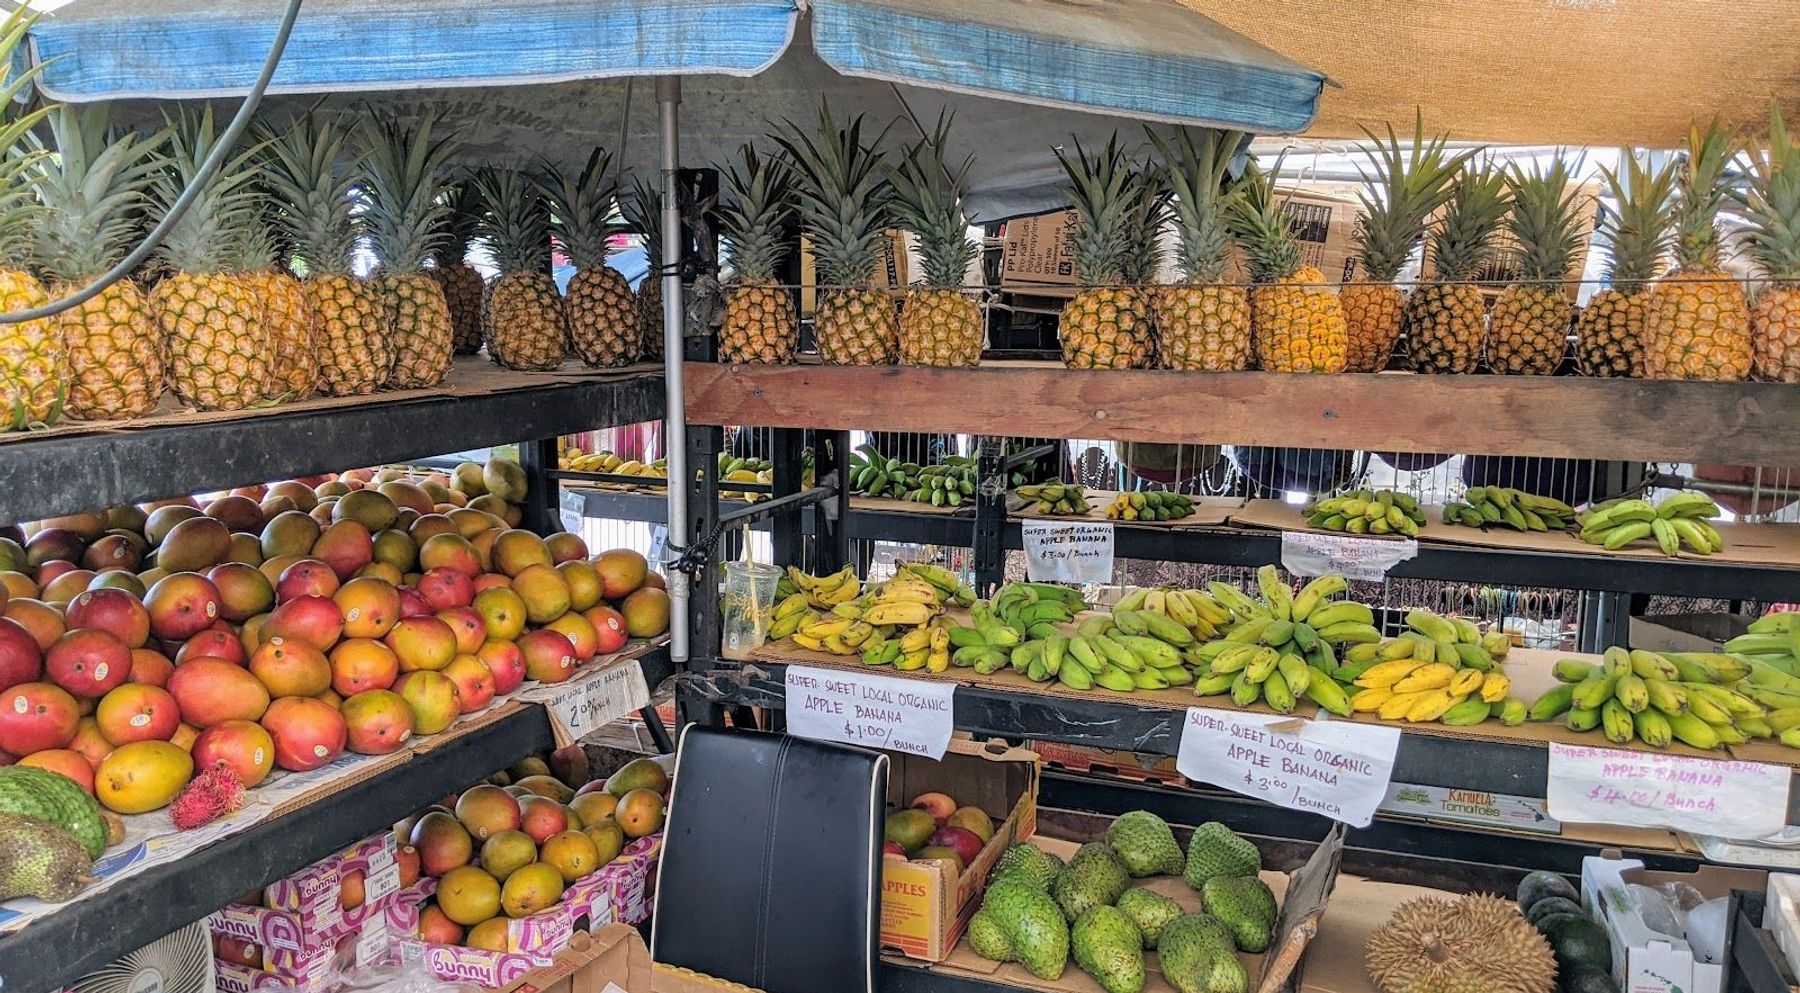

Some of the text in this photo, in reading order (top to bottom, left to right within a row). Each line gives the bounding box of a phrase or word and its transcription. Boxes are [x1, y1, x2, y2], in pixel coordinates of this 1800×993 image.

[1007, 242, 1017, 272] PP Lid
[1034, 254, 1042, 274] Clear
[1040, 536, 1107, 545] APPLE BANANA
[1050, 526, 1074, 534] SWEET
[1306, 546, 1335, 556] APPLE
[825, 680, 857, 696] SWEET
[862, 686, 894, 704] LOCAL
[898, 693, 949, 712] ORGANIC
[804, 694, 902, 724] APPLE BANANA
[894, 739, 929, 754] BUNCH
[1230, 724, 1266, 742] SWEET
[1270, 735, 1306, 756] LOCAL
[1314, 750, 1373, 776] ORGANIC
[1554, 746, 1598, 758] SUPER
[1226, 743, 1338, 786] APPLE BANANA
[1602, 764, 1724, 787] APPLE BANANA
[1449, 788, 1492, 806] KAMUELA
[1441, 800, 1500, 817] Tomatoes
[306, 873, 340, 896] bunny
[433, 952, 491, 982] bunny
